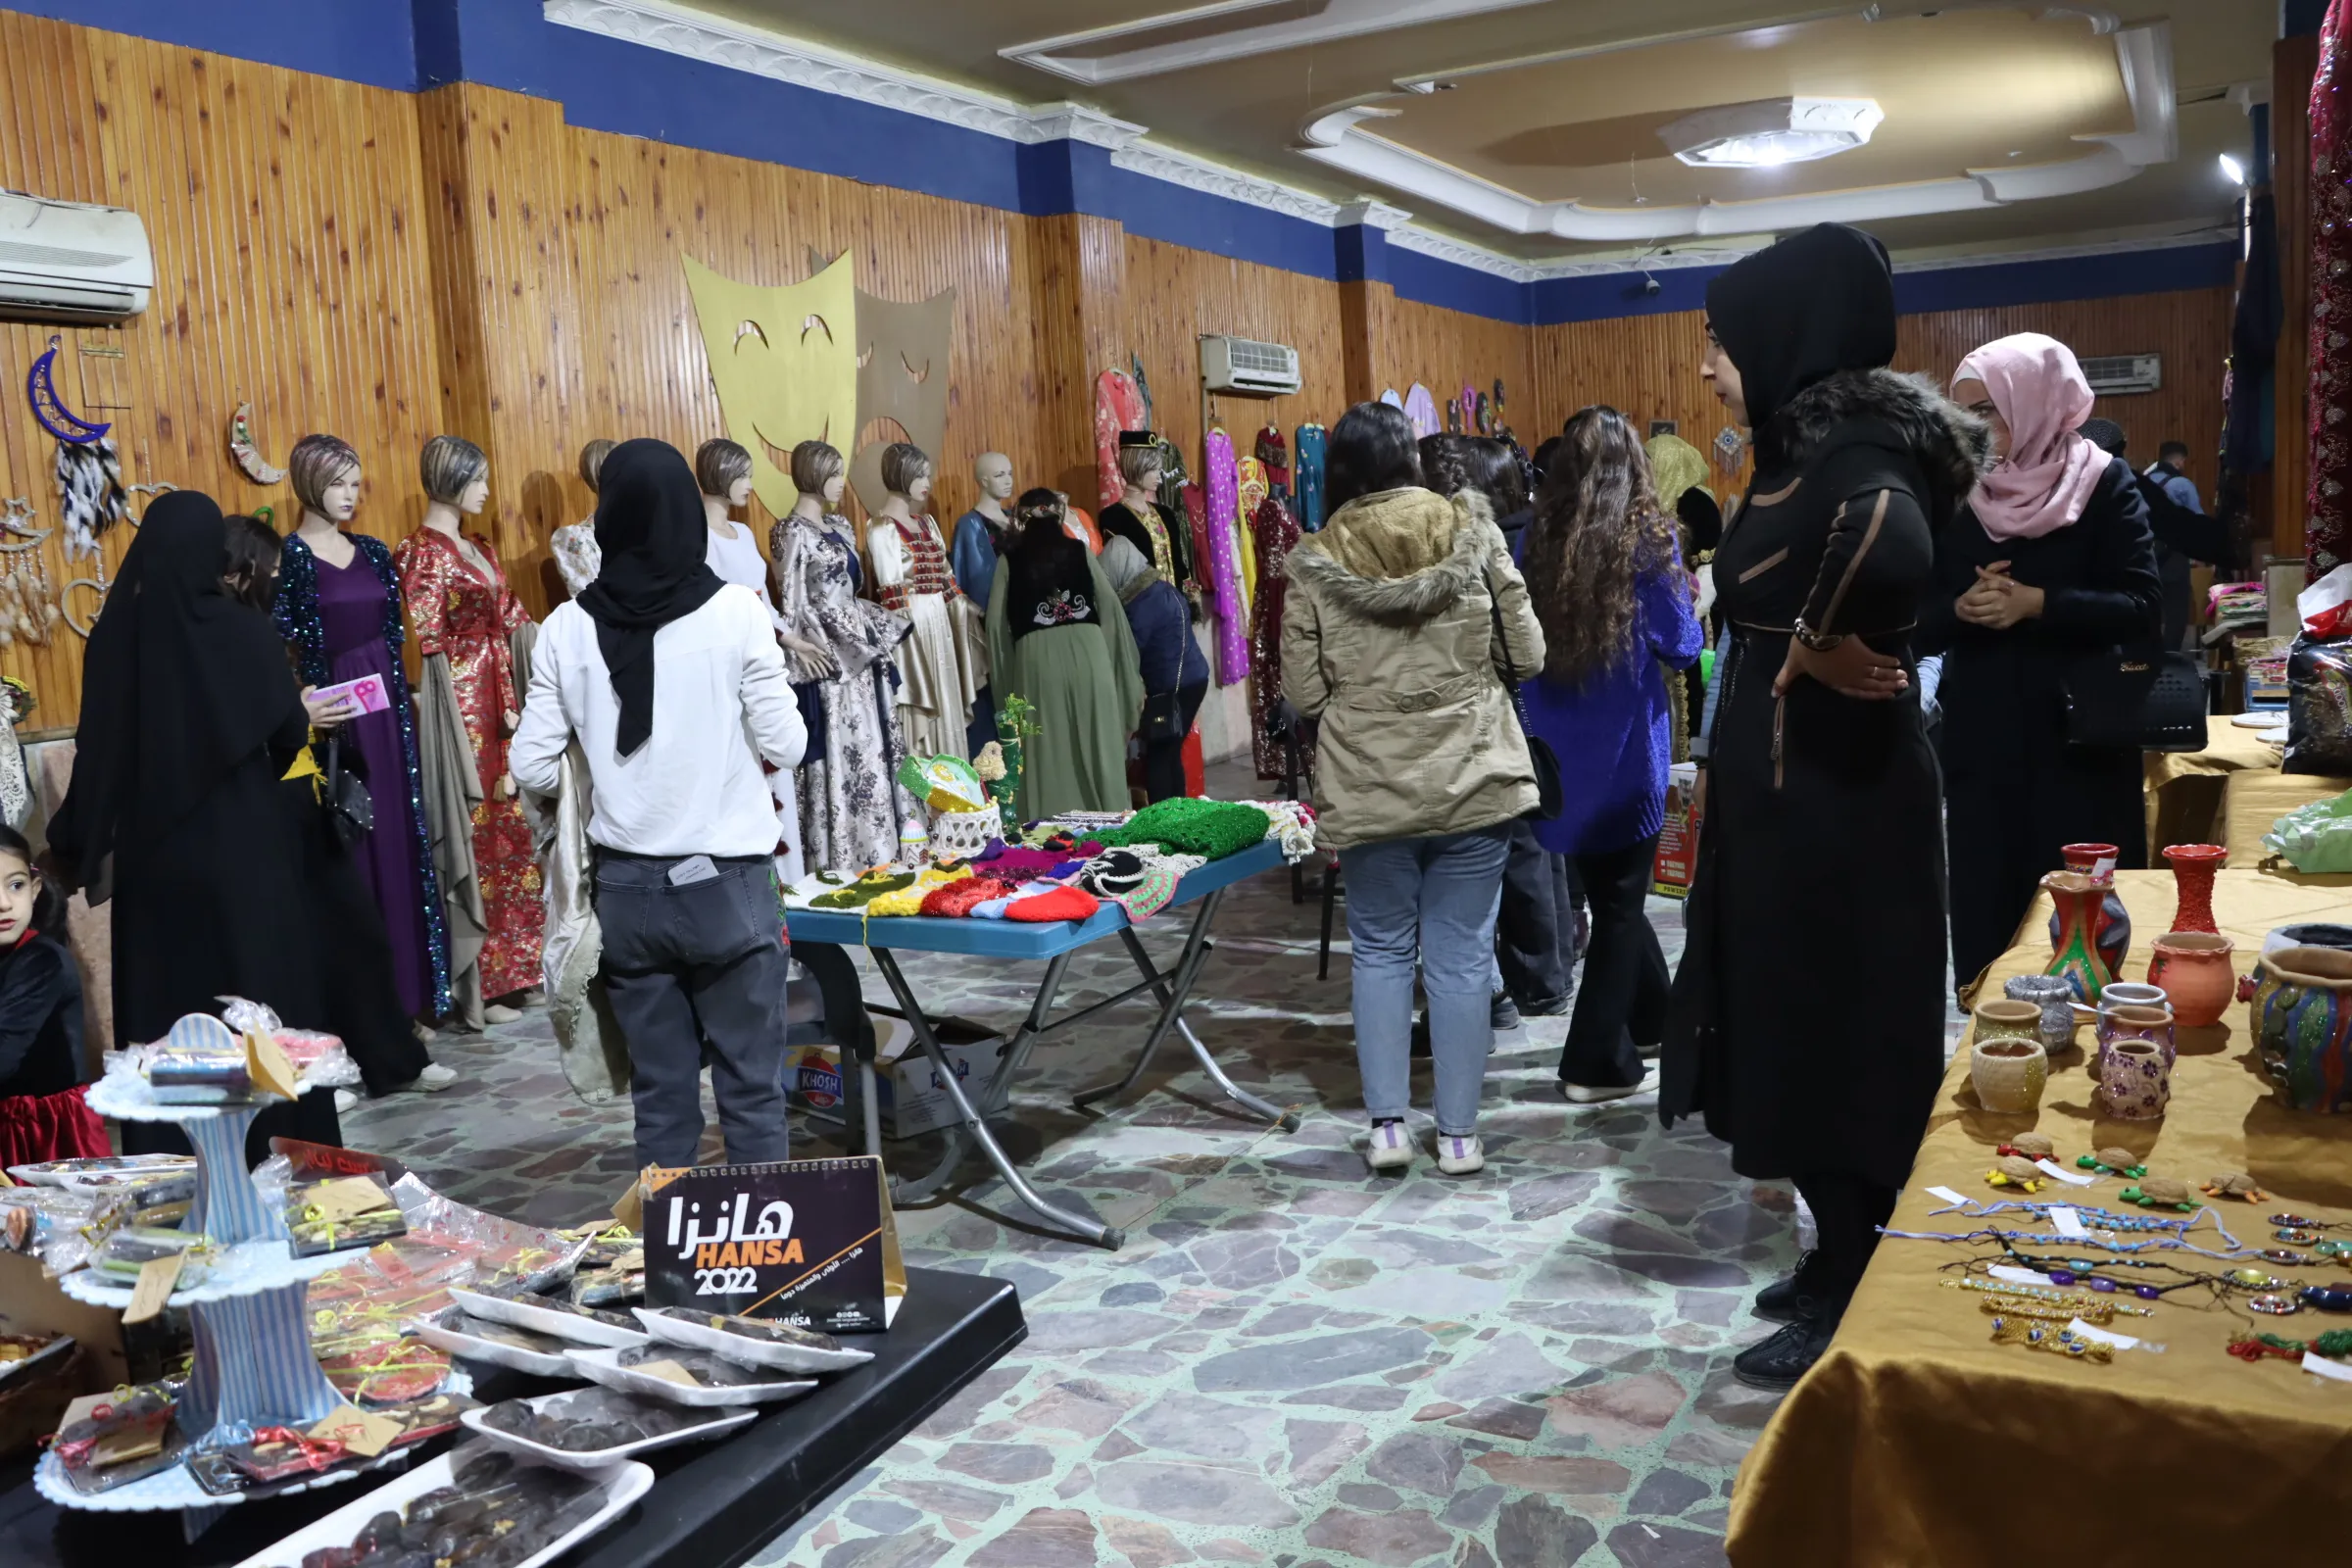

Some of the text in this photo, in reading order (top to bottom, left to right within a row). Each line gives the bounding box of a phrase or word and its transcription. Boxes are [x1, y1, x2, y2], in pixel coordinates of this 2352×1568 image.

[803, 1070, 838, 1091] KHOSH
[667, 1192, 794, 1259] هانزا
[696, 1239, 805, 1268] HANSA
[849, 1247, 863, 1259] هانزا
[694, 1266, 758, 1296] 2022
[775, 1316, 811, 1326] HANSA
